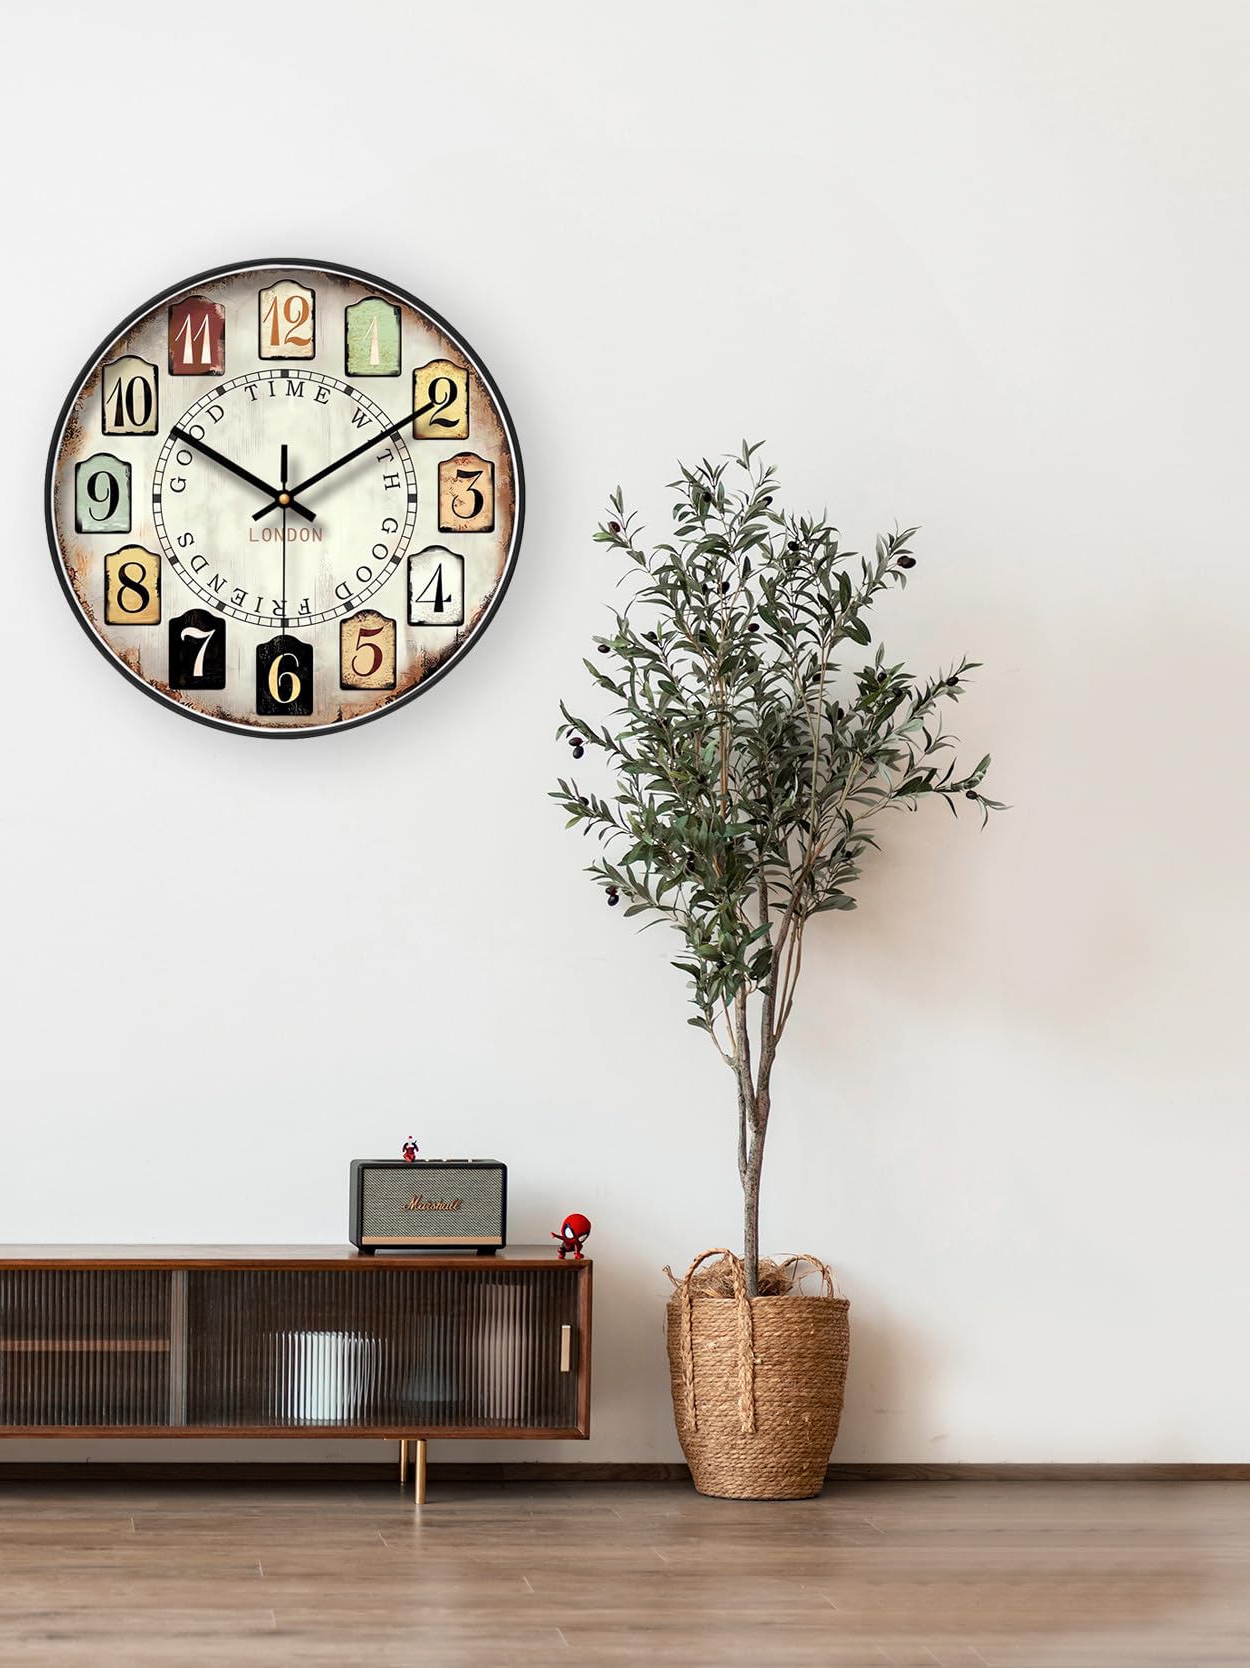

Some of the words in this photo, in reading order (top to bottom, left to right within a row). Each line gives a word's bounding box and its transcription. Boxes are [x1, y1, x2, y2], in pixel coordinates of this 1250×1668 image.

[174, 313, 212, 364] 11
[263, 294, 311, 347] 12
[362, 315, 380, 366] 1
[106, 375, 153, 427] 10
[244, 379, 331, 405] TIME
[427, 376, 460, 427] 2
[170, 404, 224, 492] GOOD
[351, 406, 400, 491] WTH
[86, 470, 120, 521] 9
[451, 469, 485, 520] 3
[249, 527, 323, 543] LONDON
[334, 517, 399, 600] GOOD
[116, 561, 150, 613] 8
[176, 532, 312, 617] FRIENDS
[415, 561, 452, 614] 4
[180, 626, 216, 677] 7
[350, 627, 385, 677] 5
[267, 652, 301, 704] 6
[402, 1194, 463, 1212] Marshall
